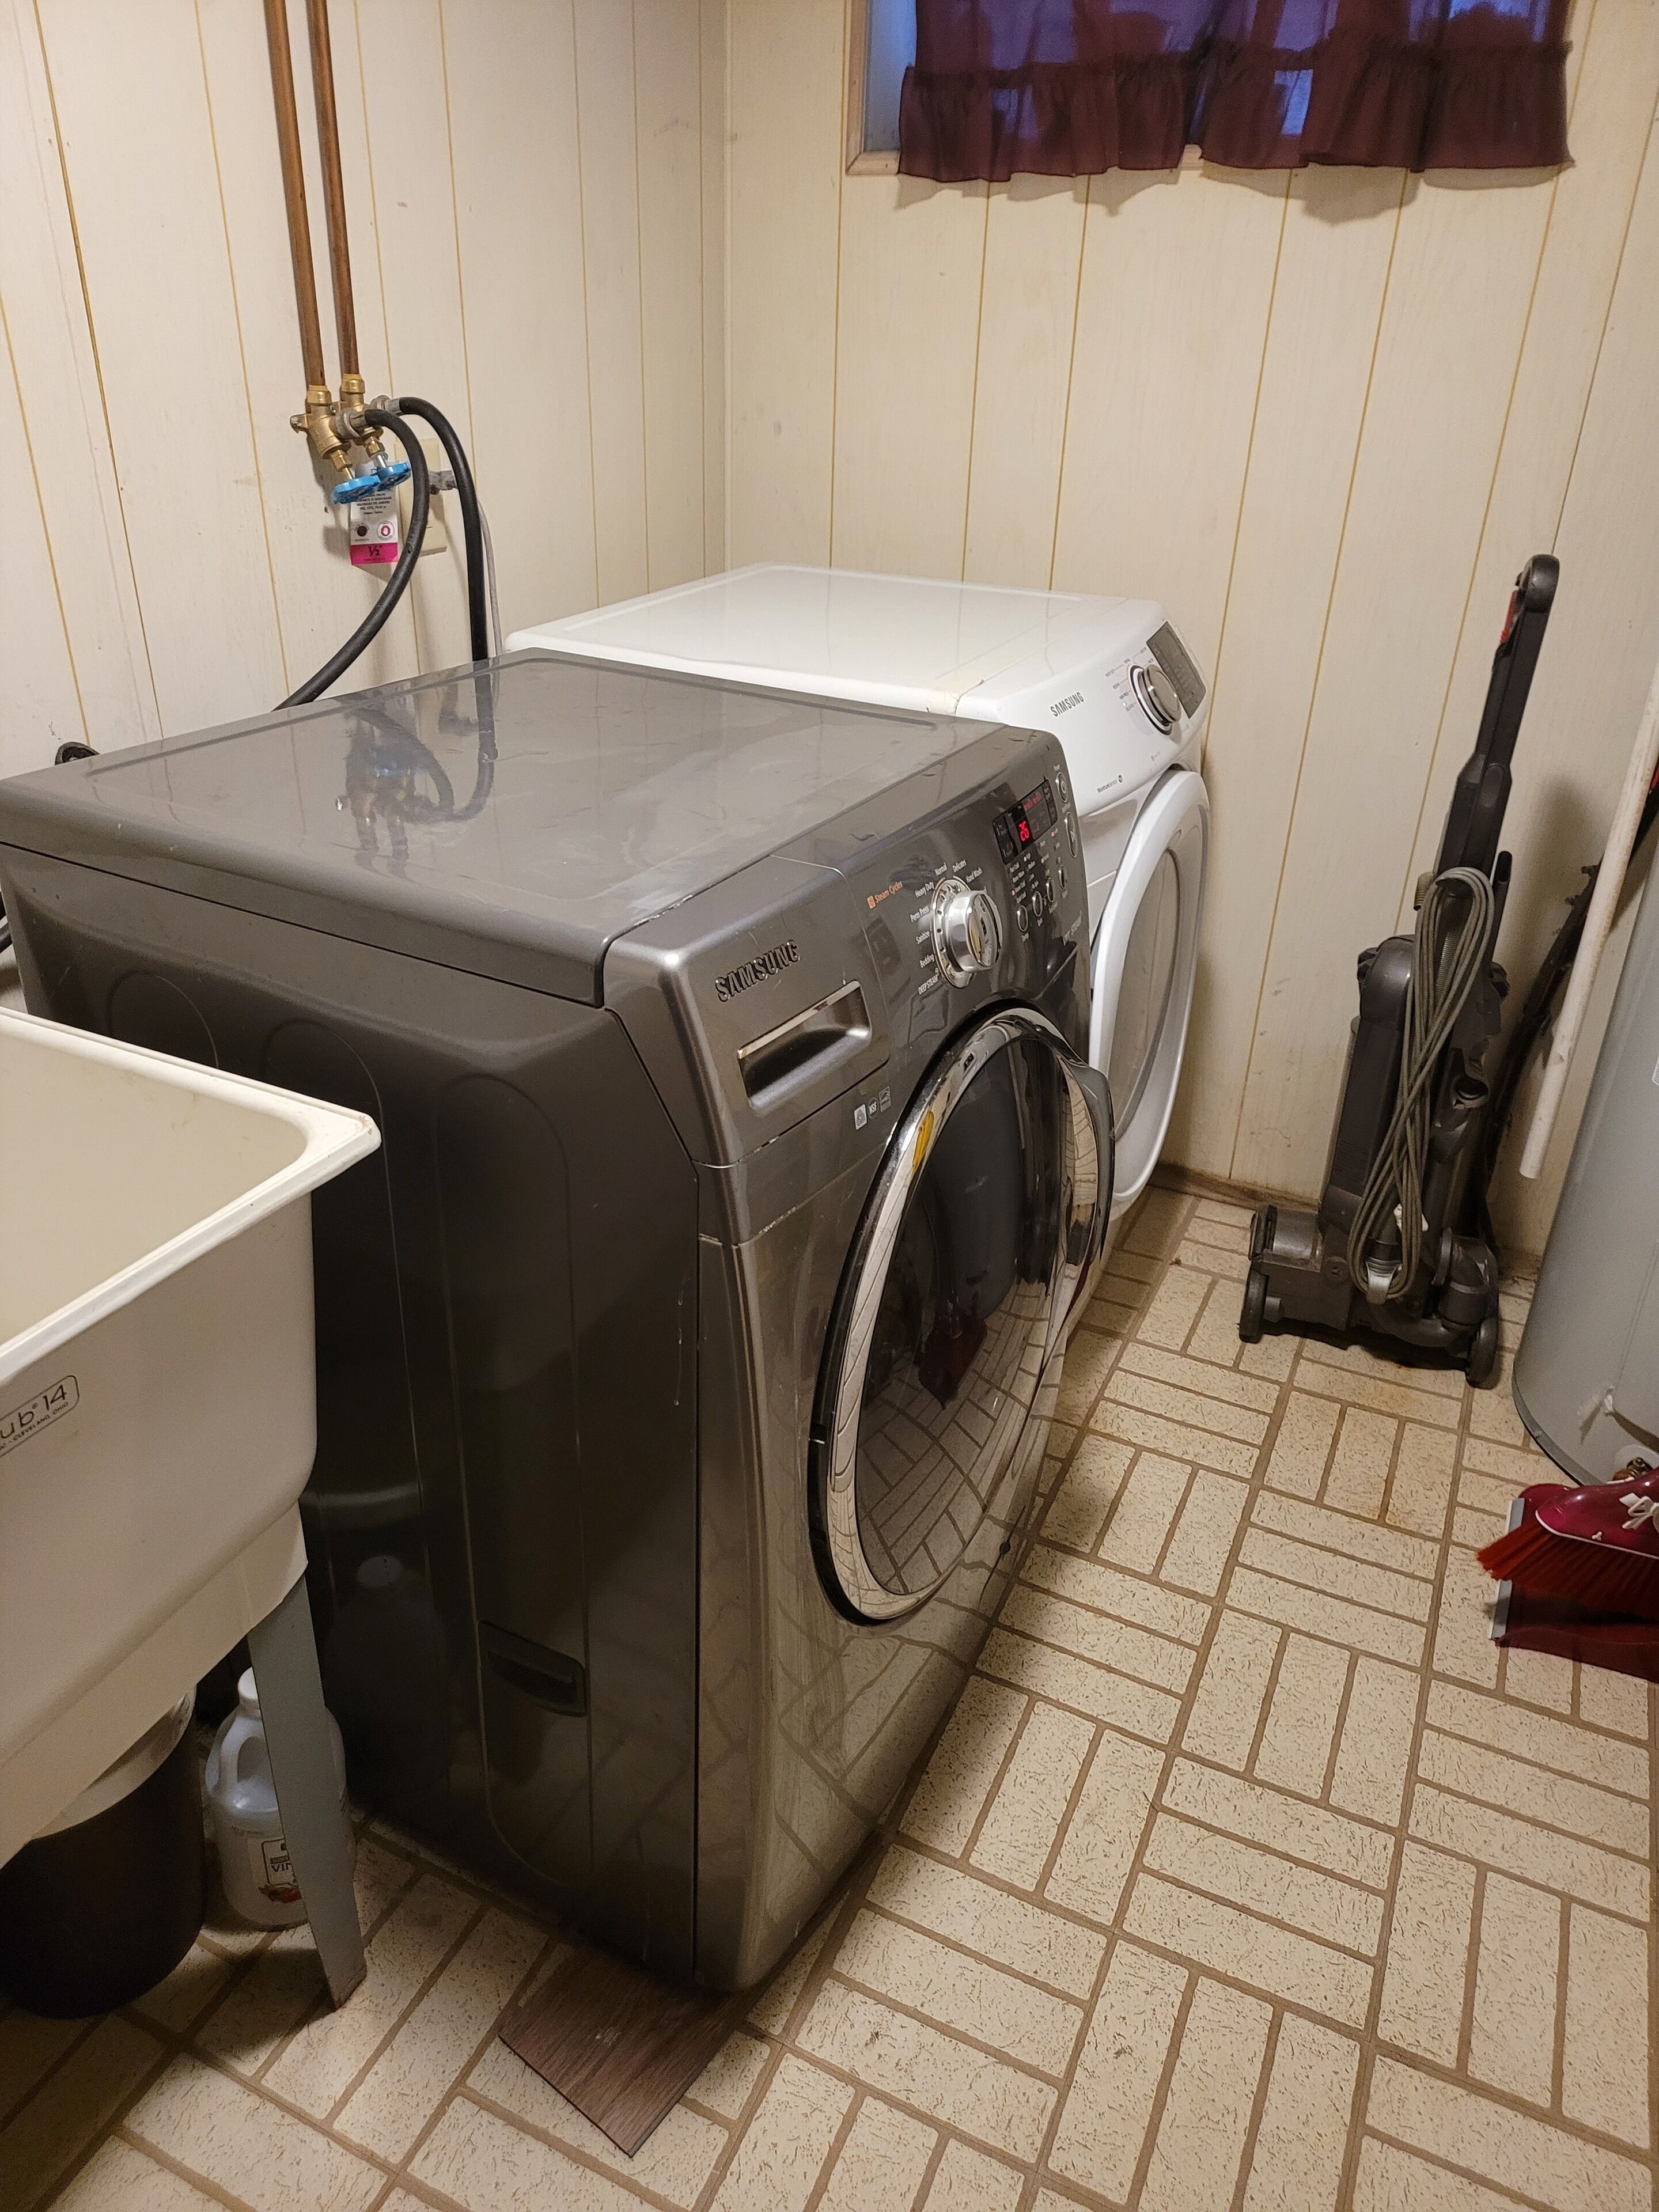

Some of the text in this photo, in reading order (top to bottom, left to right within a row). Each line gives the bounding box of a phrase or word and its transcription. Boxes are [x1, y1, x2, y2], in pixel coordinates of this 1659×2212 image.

[1050, 691, 1085, 718] SAMSUNG
[934, 862, 948, 876] Normal
[952, 859, 967, 873] Delicates
[875, 881, 903, 904] Steam Cycles
[915, 881, 934, 899] Heavy Duty
[910, 906, 930, 922] Perm Press
[919, 953, 934, 968] Bedding
[714, 939, 801, 1003] SAMSUNG
[918, 976, 938, 995] DEEP STEAM
[869, 1101, 877, 1115] NSF
[43, 1384, 67, 1411] 14
[13, 1402, 69, 1441] CLEVELAND OHIO
